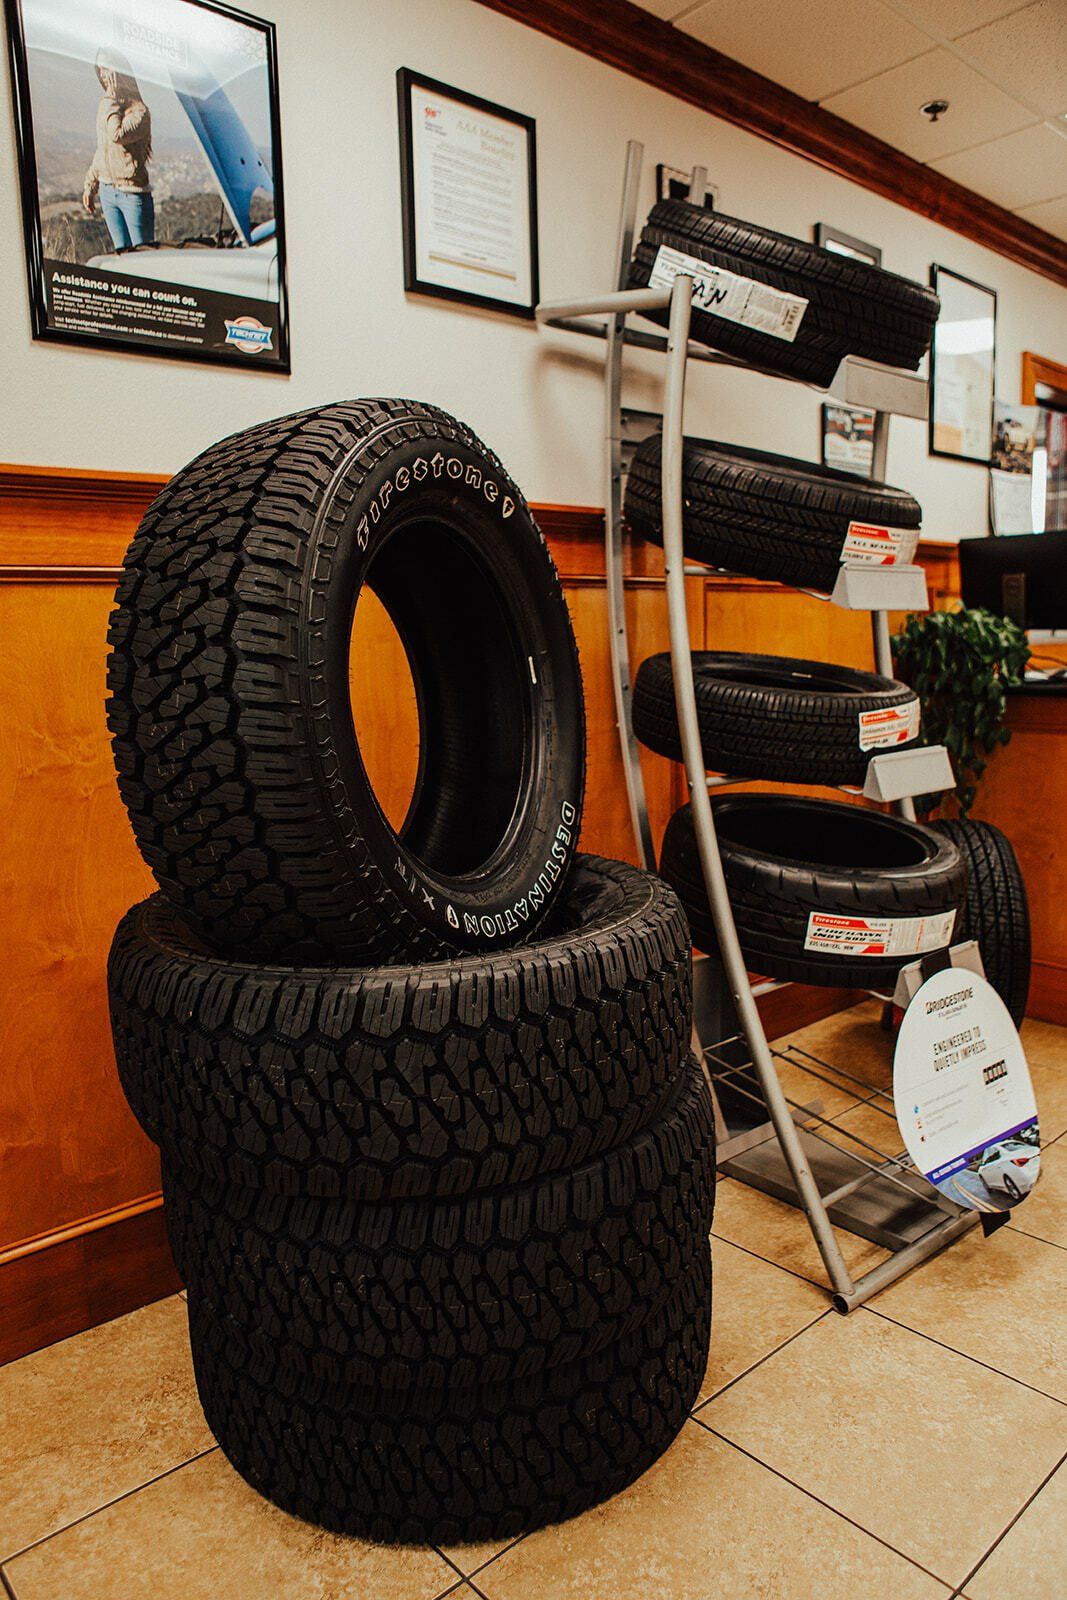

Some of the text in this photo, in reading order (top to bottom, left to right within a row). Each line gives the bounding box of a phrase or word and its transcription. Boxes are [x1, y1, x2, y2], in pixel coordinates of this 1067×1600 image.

[52, 271, 198, 307] Assistance you can count on.
[357, 452, 500, 552] Firestone
[464, 800, 576, 938] DESTINATION
[815, 916, 850, 925] Firestone
[926, 987, 973, 1015] BRIDGESTONE
[934, 1029, 972, 1056] ENGINEERED
[960, 1039, 987, 1060] IMPRESS
